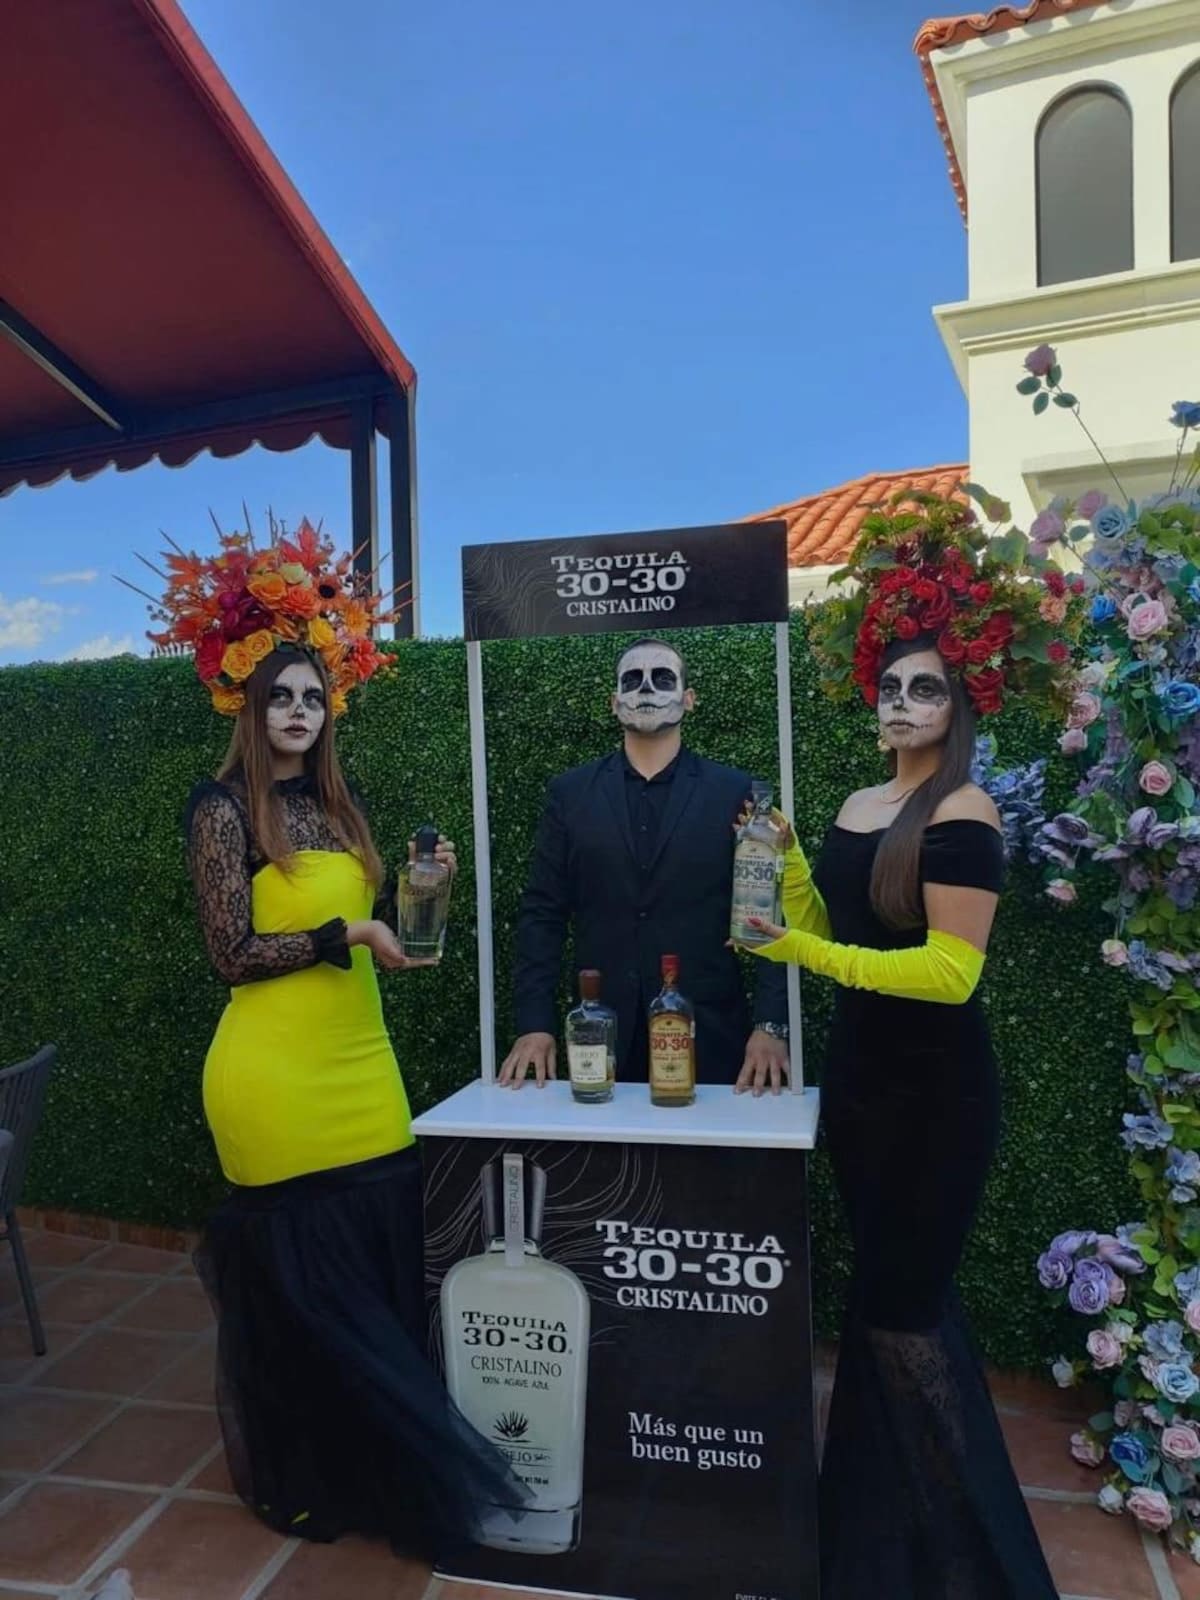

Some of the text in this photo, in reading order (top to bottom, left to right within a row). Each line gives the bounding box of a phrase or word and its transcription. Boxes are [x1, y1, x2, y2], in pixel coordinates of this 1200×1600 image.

[551, 550, 687, 573] TEQUILA
[556, 567, 686, 598] 30-30
[566, 596, 676, 617] CRISTALINO
[596, 1220, 785, 1254] TEQUILA
[602, 1246, 784, 1290] 30-30
[616, 1286, 769, 1316] CRISTALINO
[462, 1311, 568, 1333] TEQUILA
[463, 1327, 568, 1354] 30-30
[471, 1355, 562, 1378] CRISTALINO
[628, 1412, 765, 1445] Más que un
[631, 1436, 762, 1470] buen gusto
